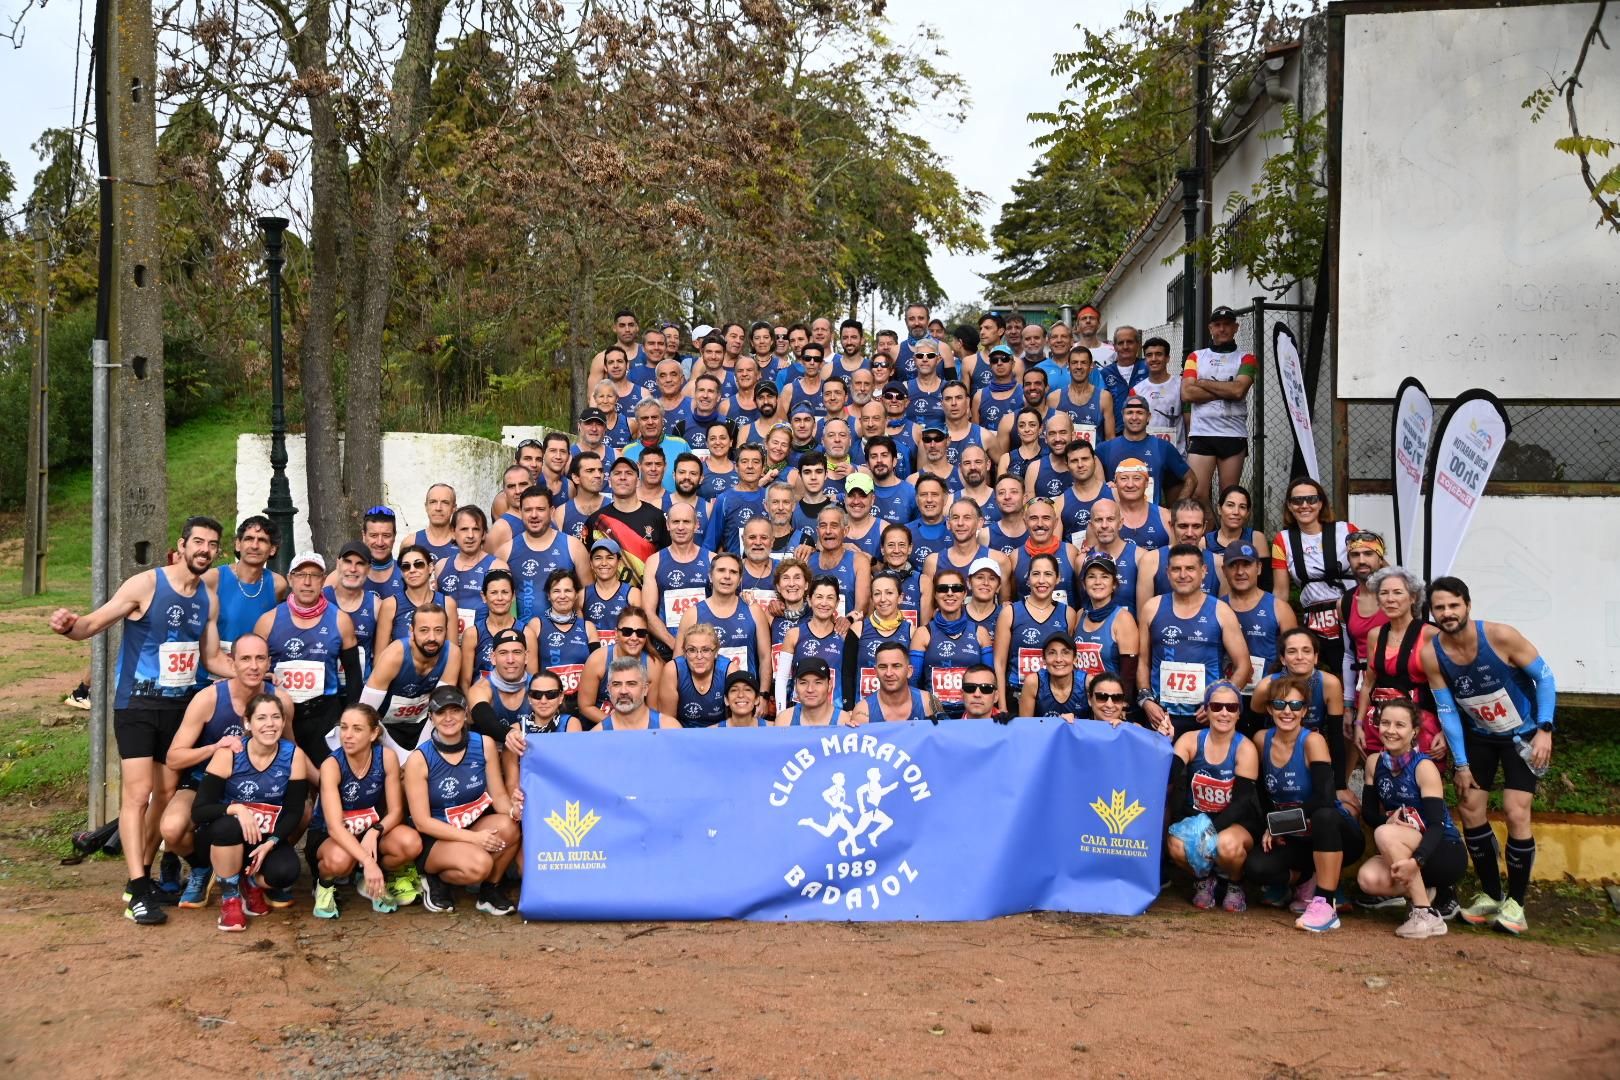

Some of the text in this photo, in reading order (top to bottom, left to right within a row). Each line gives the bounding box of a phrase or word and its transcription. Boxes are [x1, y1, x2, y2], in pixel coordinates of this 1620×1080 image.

[168, 653, 195, 673] 354
[282, 671, 316, 690] 399
[1166, 672, 1197, 692] 473
[769, 733, 932, 807] CLUB MARATON
[1080, 834, 1149, 850] CAJA RURAL
[537, 850, 607, 862] CAJA RURAL
[1092, 846, 1148, 858] EXTREMADURA
[537, 862, 606, 871] DE EXTREMADURA
[825, 859, 877, 881] 1989
[783, 860, 919, 911] BADAJOZ
